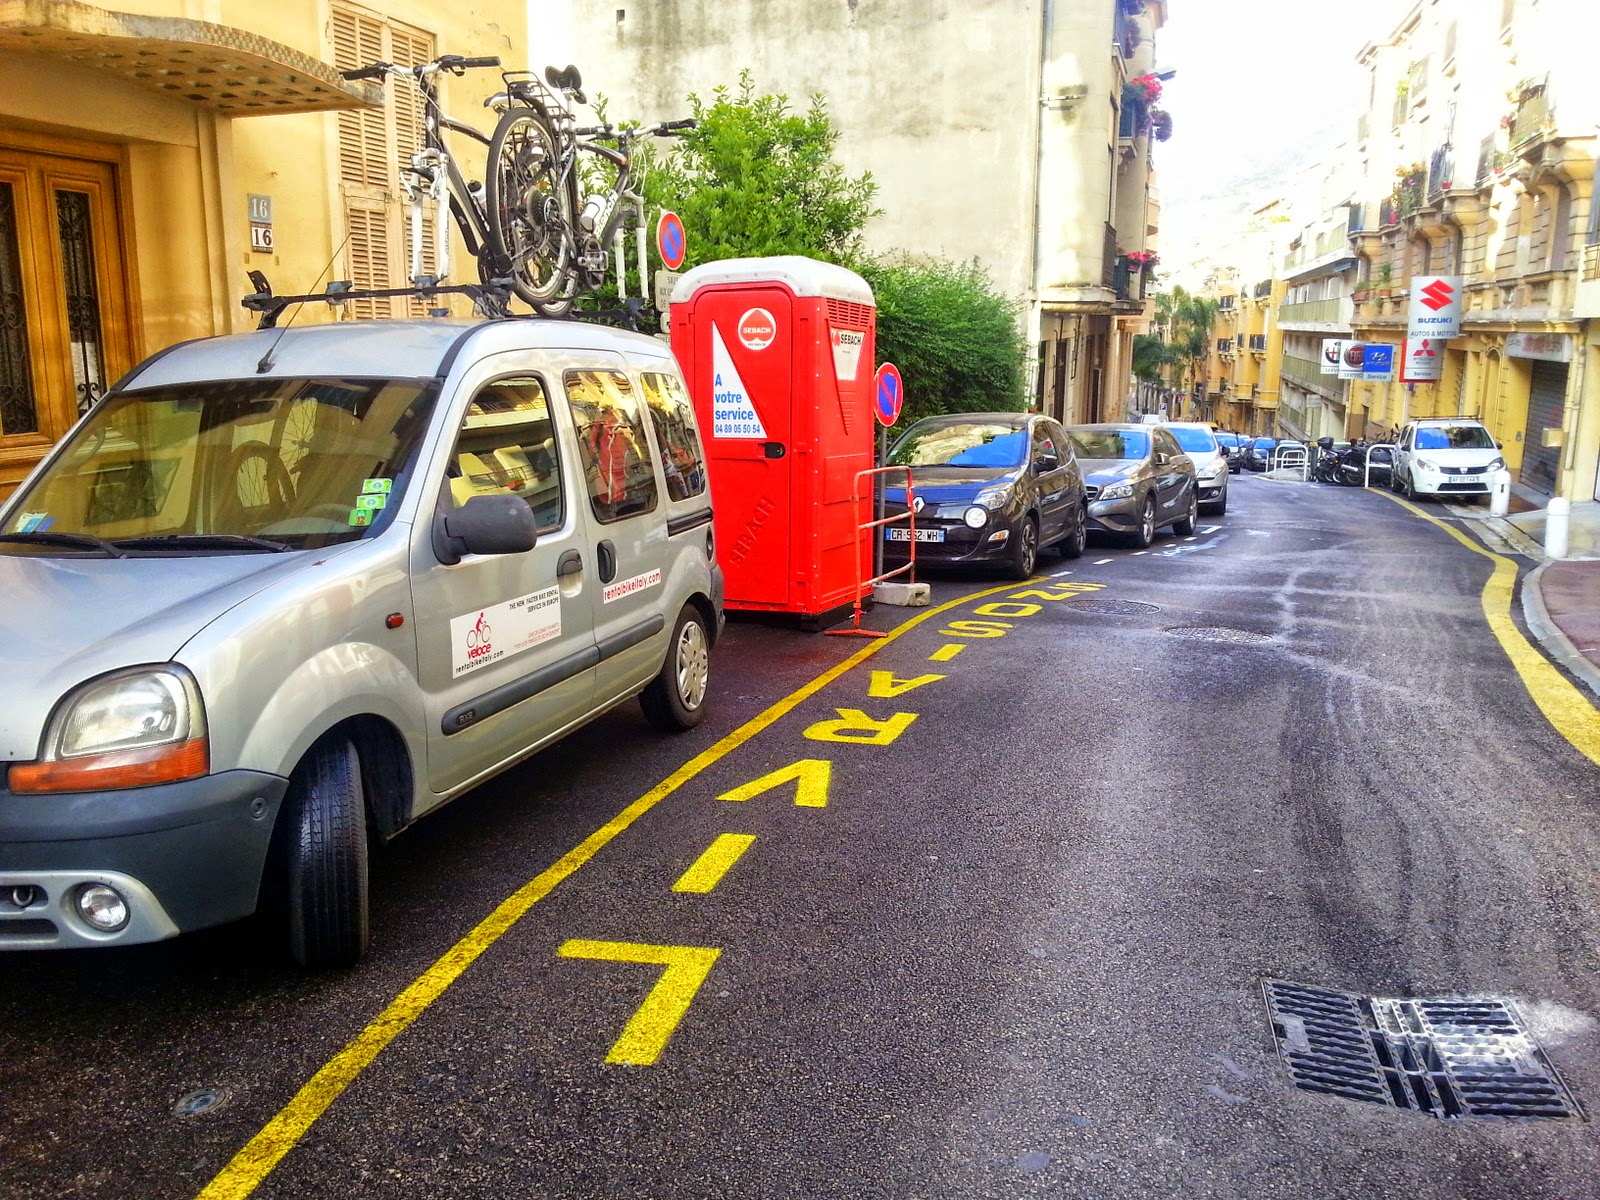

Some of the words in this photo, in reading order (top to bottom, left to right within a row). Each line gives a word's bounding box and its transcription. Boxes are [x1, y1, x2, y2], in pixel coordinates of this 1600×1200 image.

[252, 198, 268, 219] 16
[254, 228, 272, 246] 16
[841, 333, 861, 346] SEBACH
[715, 373, 722, 387] A
[715, 391, 742, 403] votre
[715, 408, 754, 420] service
[715, 424, 723, 434] 04
[724, 424, 732, 434] 89
[733, 424, 742, 434] 05
[743, 424, 751, 434] 50
[752, 424, 760, 434] 54
[729, 495, 775, 568] SEBACH
[547, 589, 559, 597] RENTAL
[604, 572, 661, 601] rentalbikeitaly.com
[527, 602, 542, 613] SERVICE
[546, 596, 559, 606] EUROPE
[467, 643, 492, 660] veloce
[455, 649, 505, 674] rentalbikeitaly.com
[459, 711, 474, 724] RXE
[557, 582, 1107, 1066] LIVRAISONS
